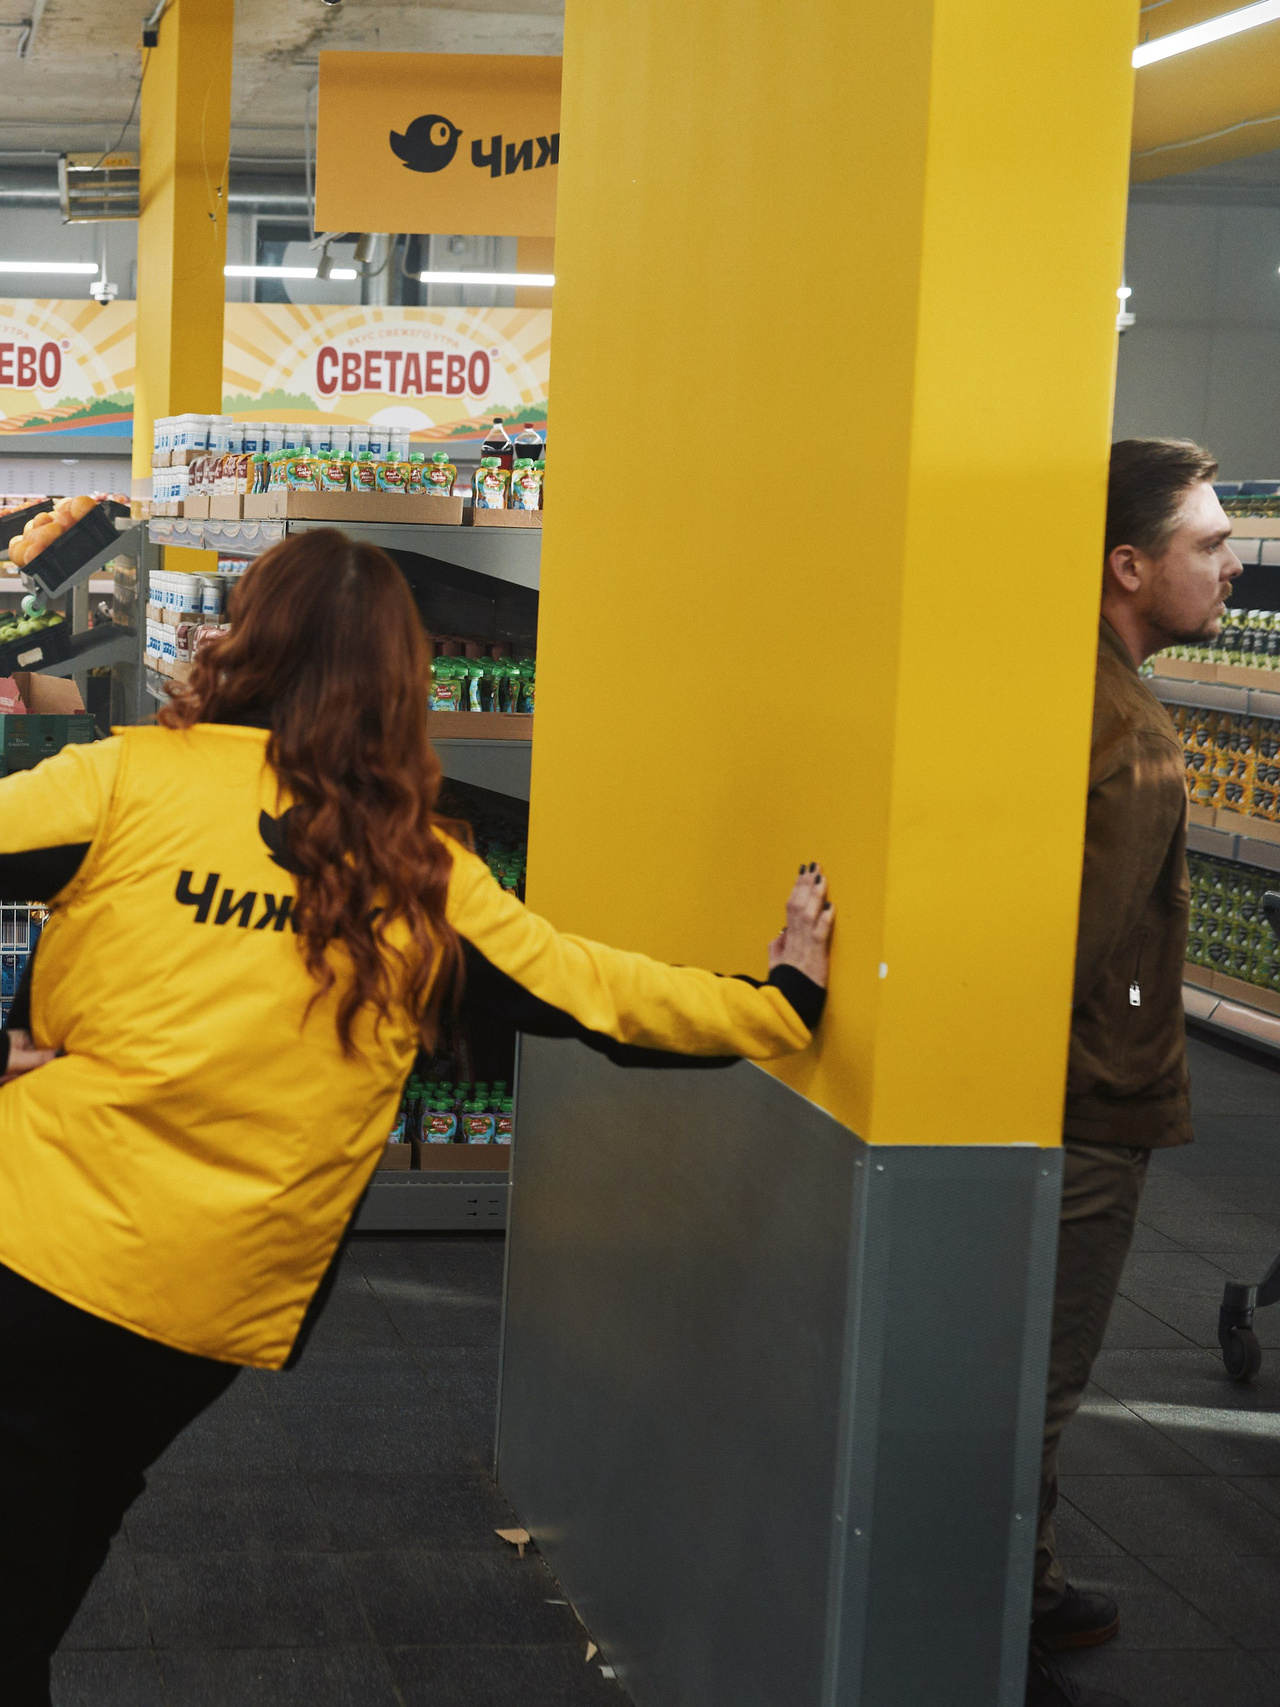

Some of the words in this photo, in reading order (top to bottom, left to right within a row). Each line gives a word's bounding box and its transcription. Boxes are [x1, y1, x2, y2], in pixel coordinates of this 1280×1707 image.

[471, 133, 560, 178] Чиж
[316, 346, 490, 395] СВЕТАЕВО
[175, 870, 302, 935] Чиж
